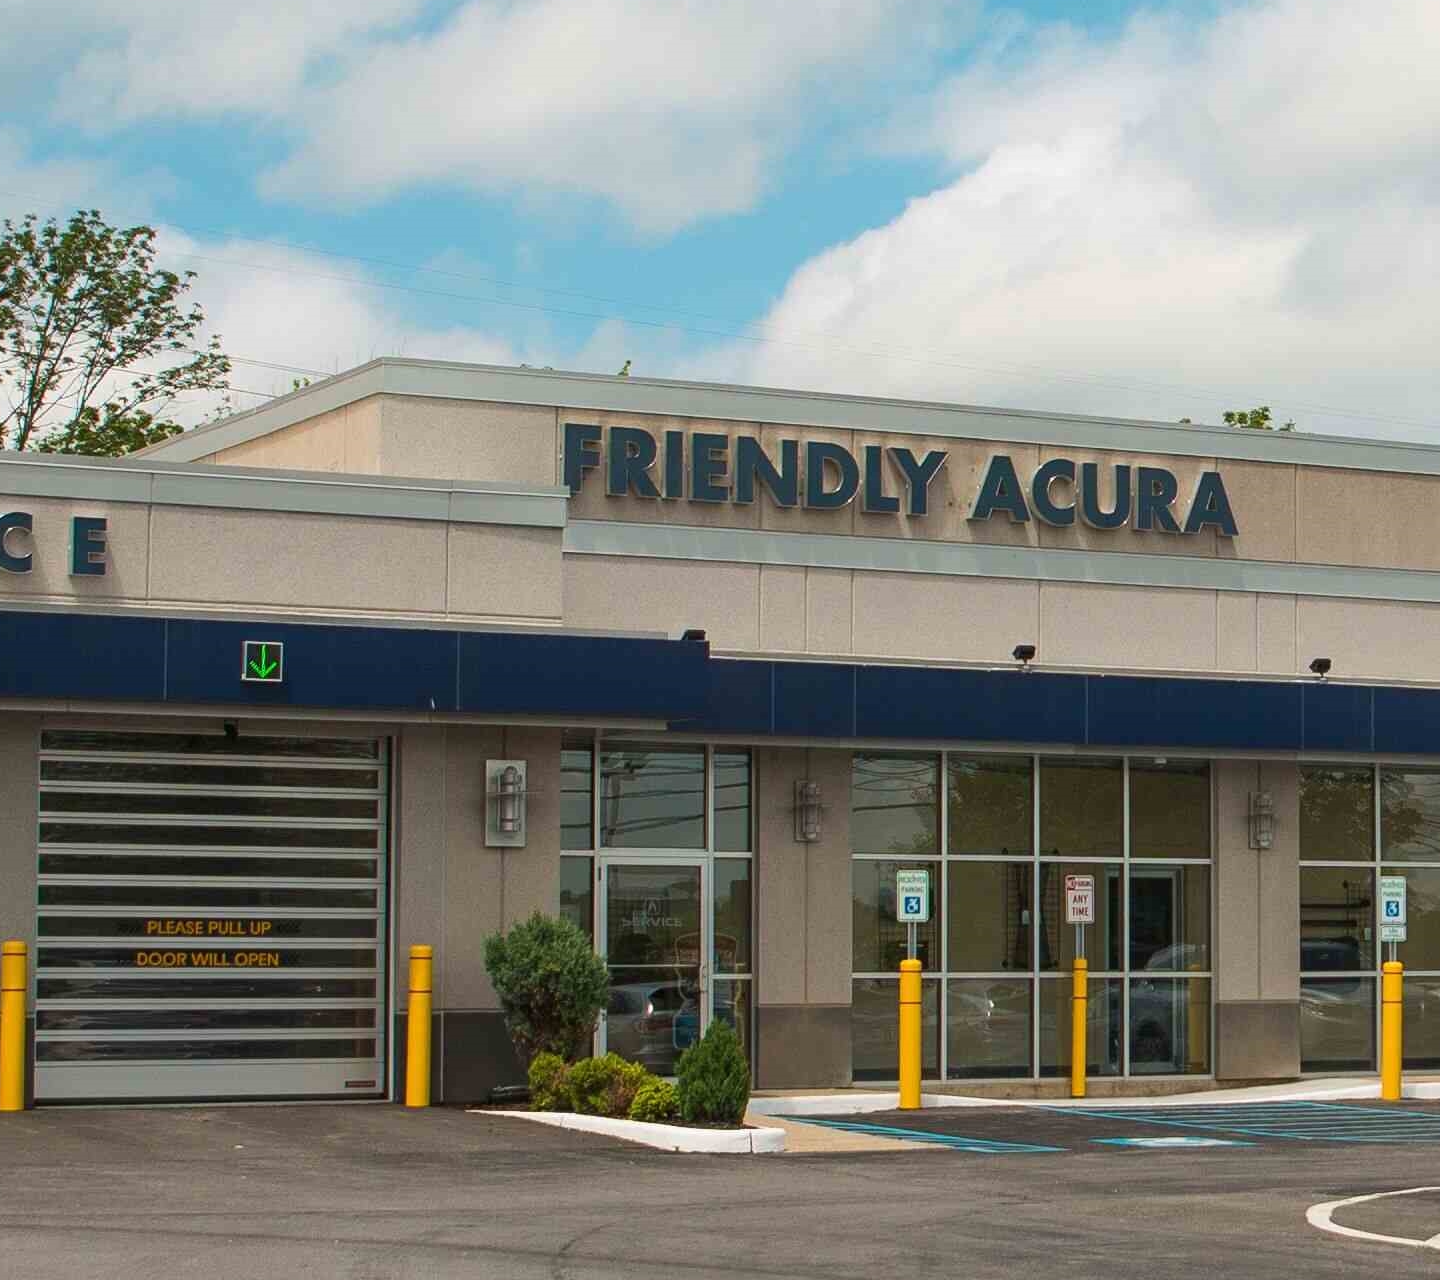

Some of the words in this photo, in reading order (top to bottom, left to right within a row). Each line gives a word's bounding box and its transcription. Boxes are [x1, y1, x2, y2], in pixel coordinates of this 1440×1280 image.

[562, 422, 952, 517] FRIENDLY
[966, 454, 1240, 537] ACURA
[1072, 895, 1089, 904] ANY
[1072, 907, 1089, 916] TIME
[147, 920, 204, 935] PLEASE
[208, 921, 247, 935] PULL
[250, 921, 272, 935] UP
[137, 952, 187, 966] DOOR
[191, 952, 230, 966] WILL
[234, 952, 280, 966] OPEN
